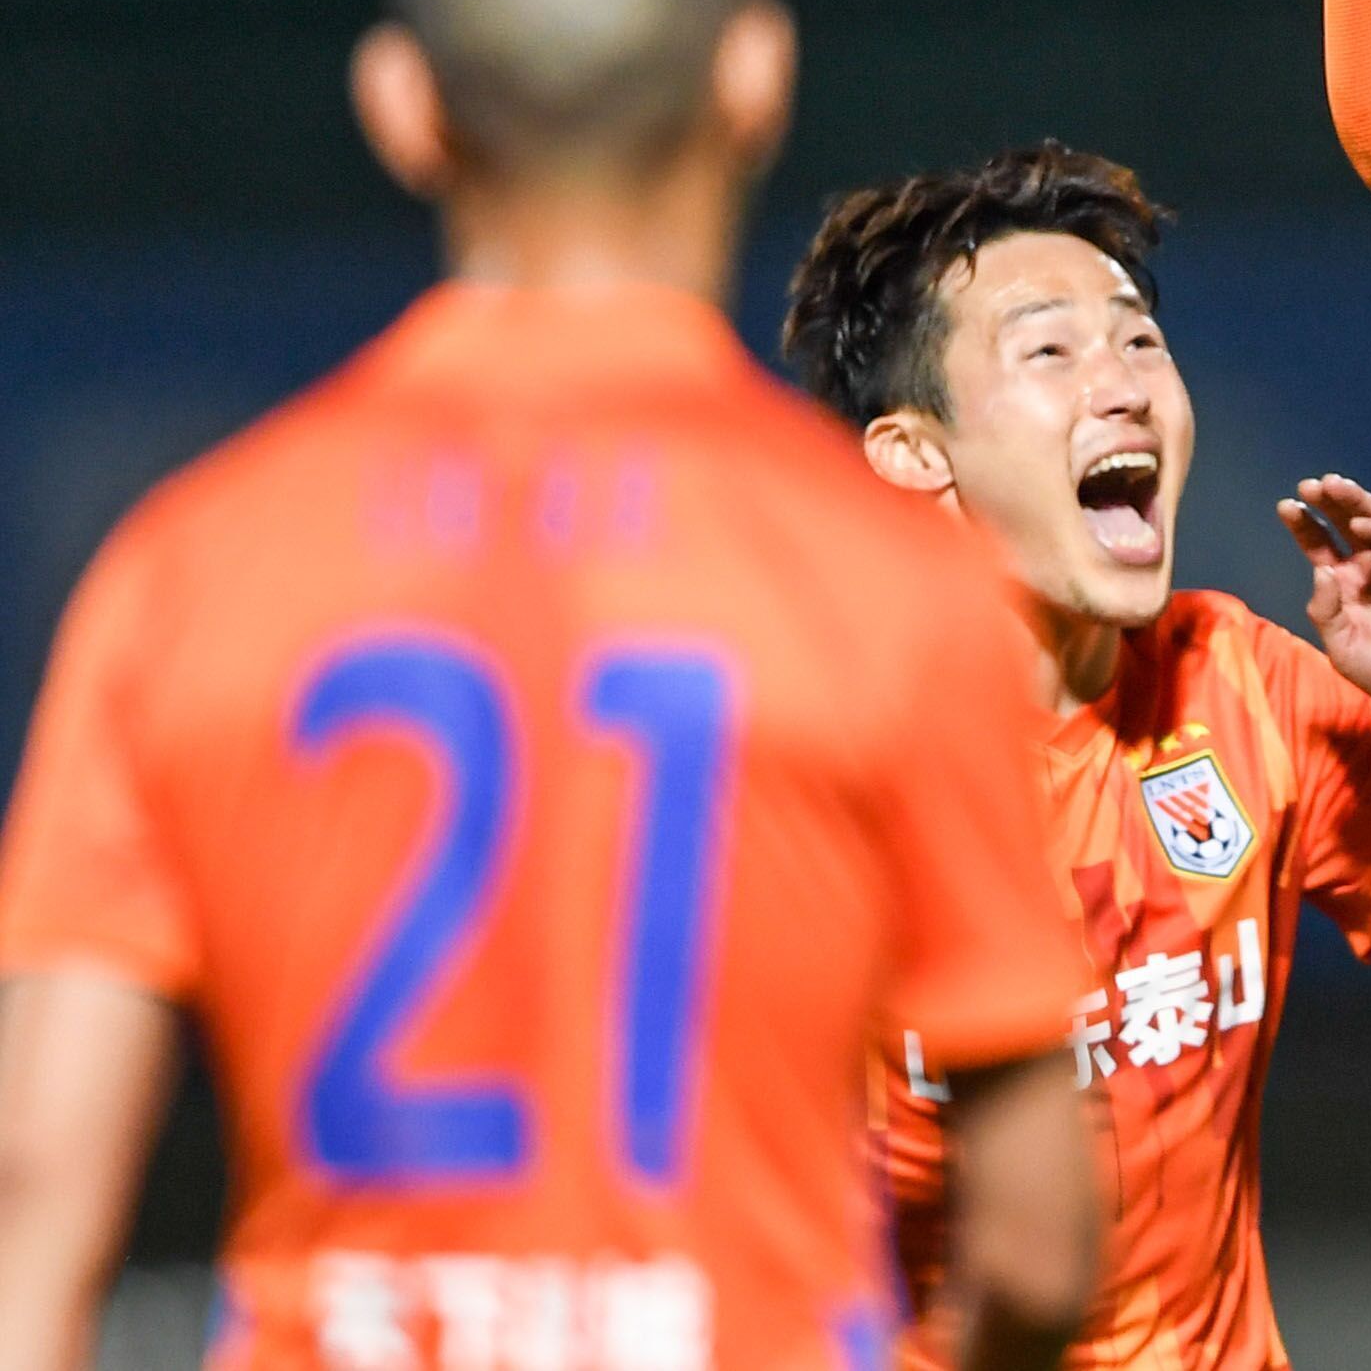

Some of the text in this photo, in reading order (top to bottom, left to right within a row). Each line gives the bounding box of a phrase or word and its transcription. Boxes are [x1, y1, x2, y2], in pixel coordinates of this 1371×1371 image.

[292, 632, 735, 1189] 21
[904, 917, 1266, 1103] 东泰山
